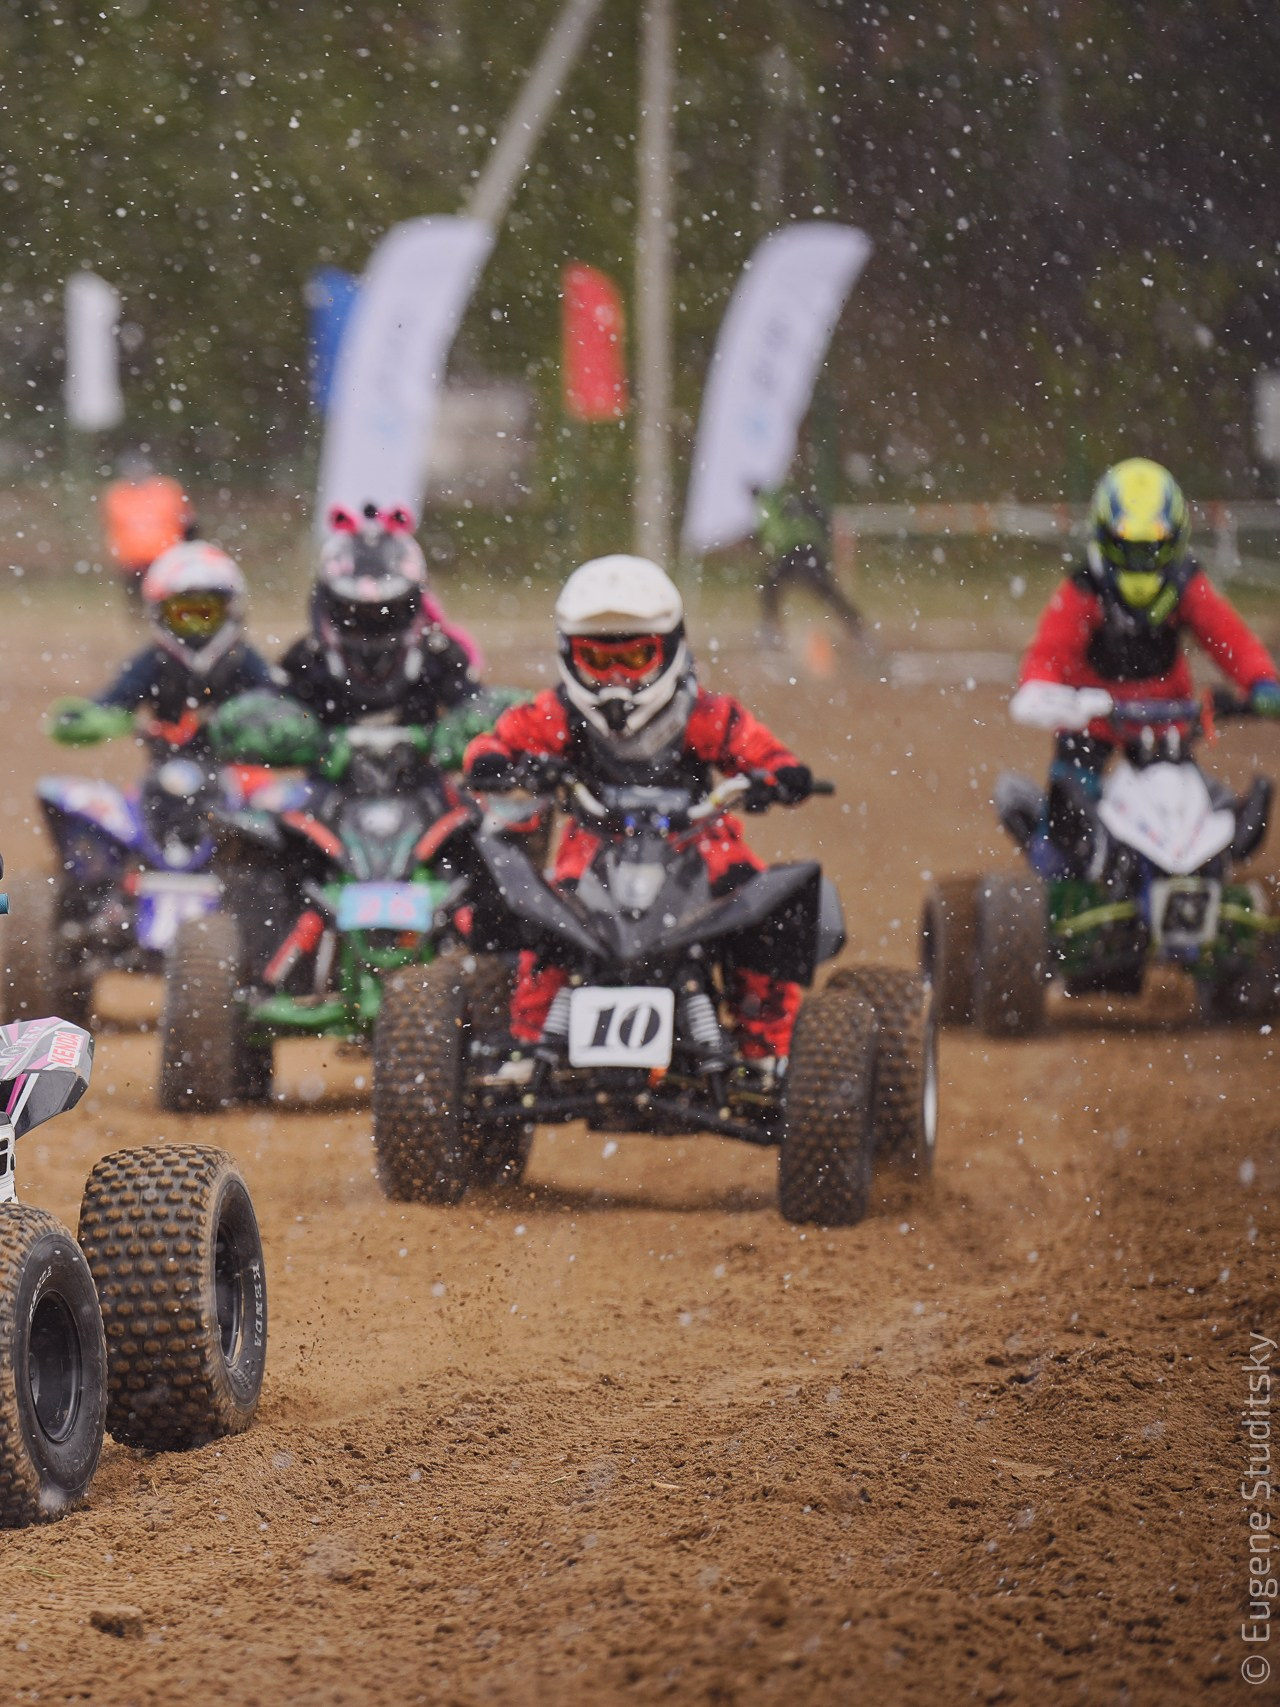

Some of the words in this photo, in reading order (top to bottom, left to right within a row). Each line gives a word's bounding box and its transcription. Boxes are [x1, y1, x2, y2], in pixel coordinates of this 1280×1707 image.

[48, 1031, 82, 1067] KENDA
[588, 1003, 661, 1049] 10
[252, 1263, 263, 1348] KENDA
